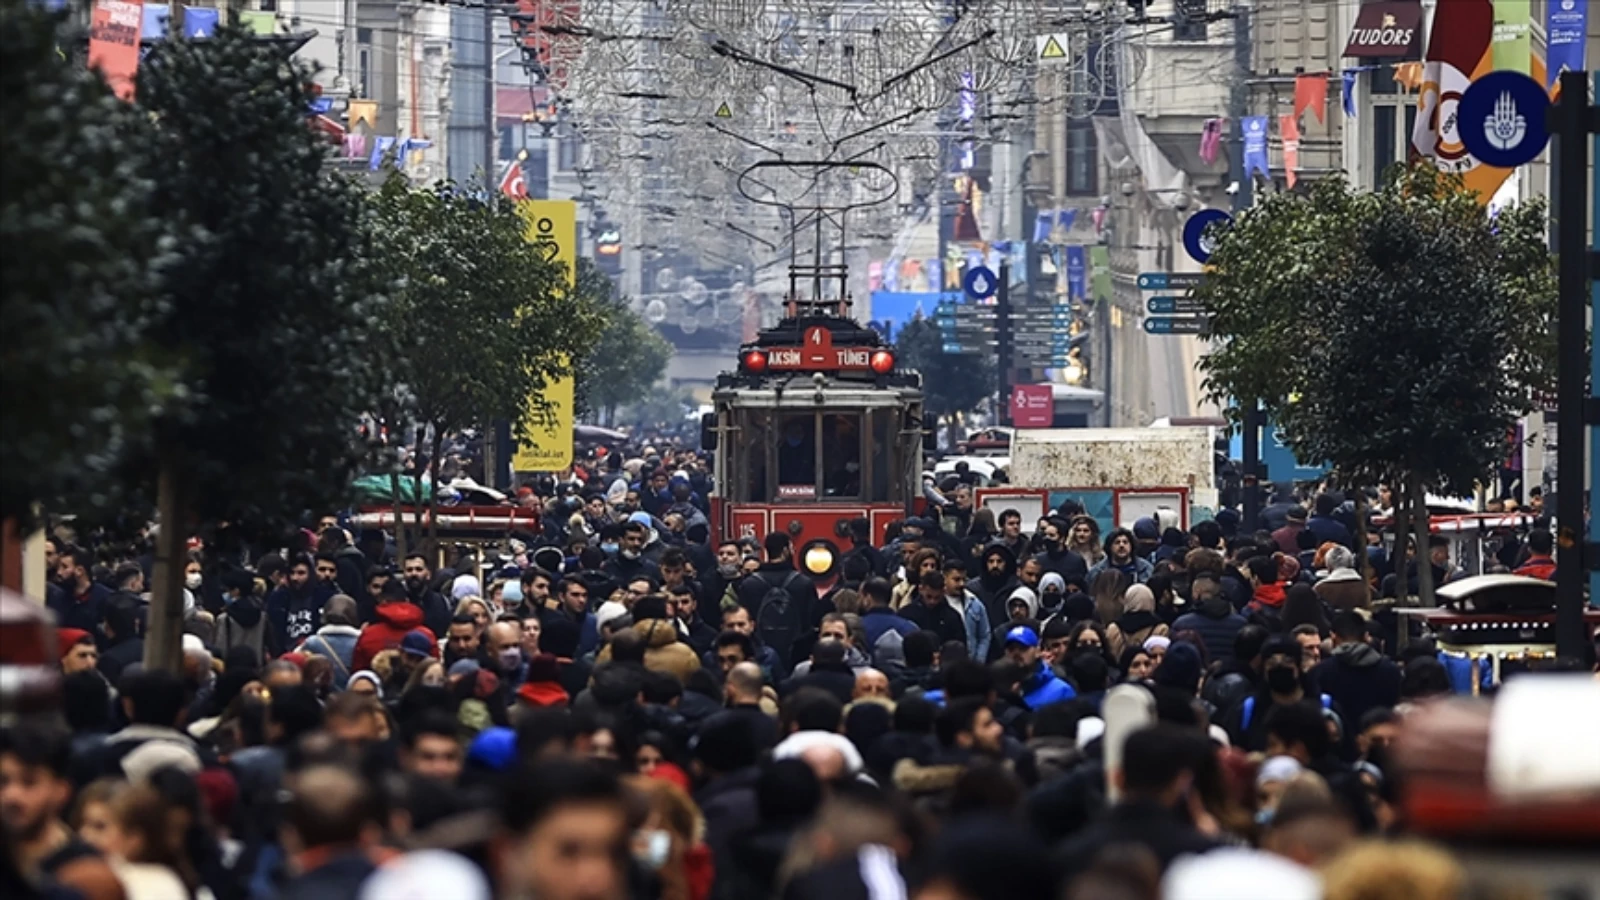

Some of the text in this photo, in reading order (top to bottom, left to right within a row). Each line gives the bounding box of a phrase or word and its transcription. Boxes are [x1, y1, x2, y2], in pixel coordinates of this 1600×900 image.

[1350, 28, 1414, 46] TUDORS
[812, 328, 821, 345] 4
[768, 349, 801, 366] AKSİM
